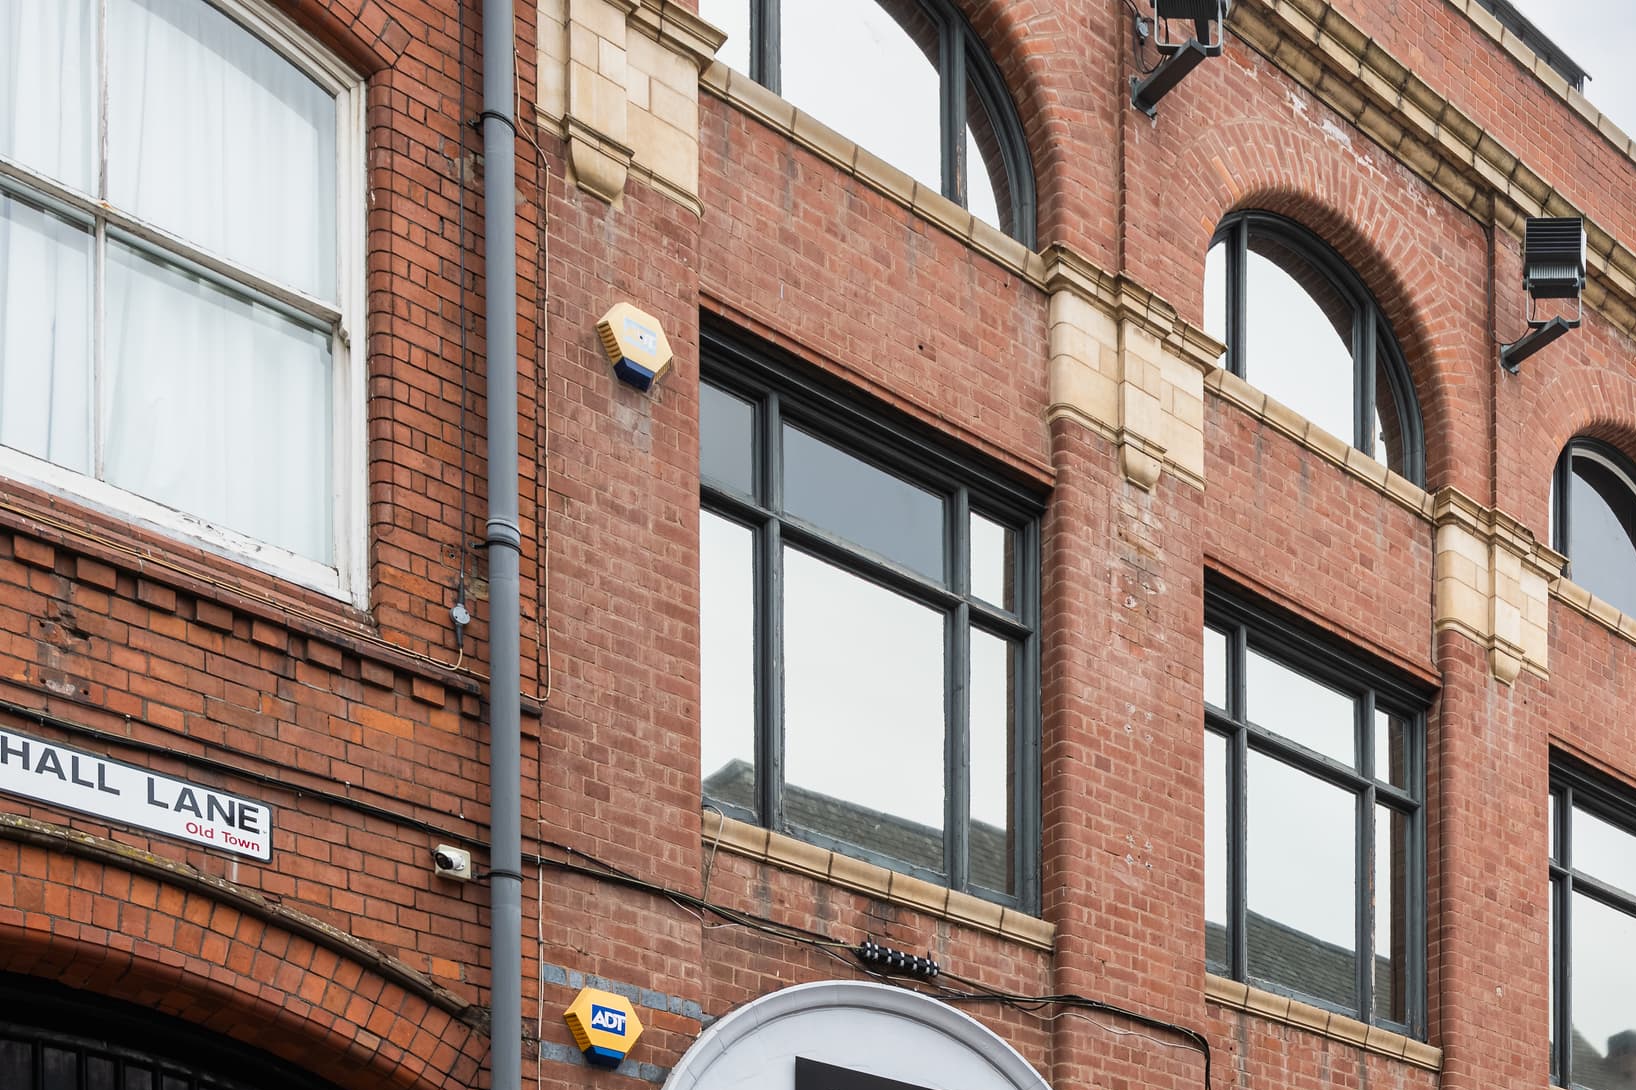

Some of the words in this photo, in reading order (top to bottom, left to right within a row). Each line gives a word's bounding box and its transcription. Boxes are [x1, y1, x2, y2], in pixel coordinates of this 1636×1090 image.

[1, 735, 120, 796] HALL
[147, 777, 260, 834] LANE
[186, 822, 214, 839] Old
[221, 831, 260, 852] Town
[592, 1009, 626, 1031] ADT
